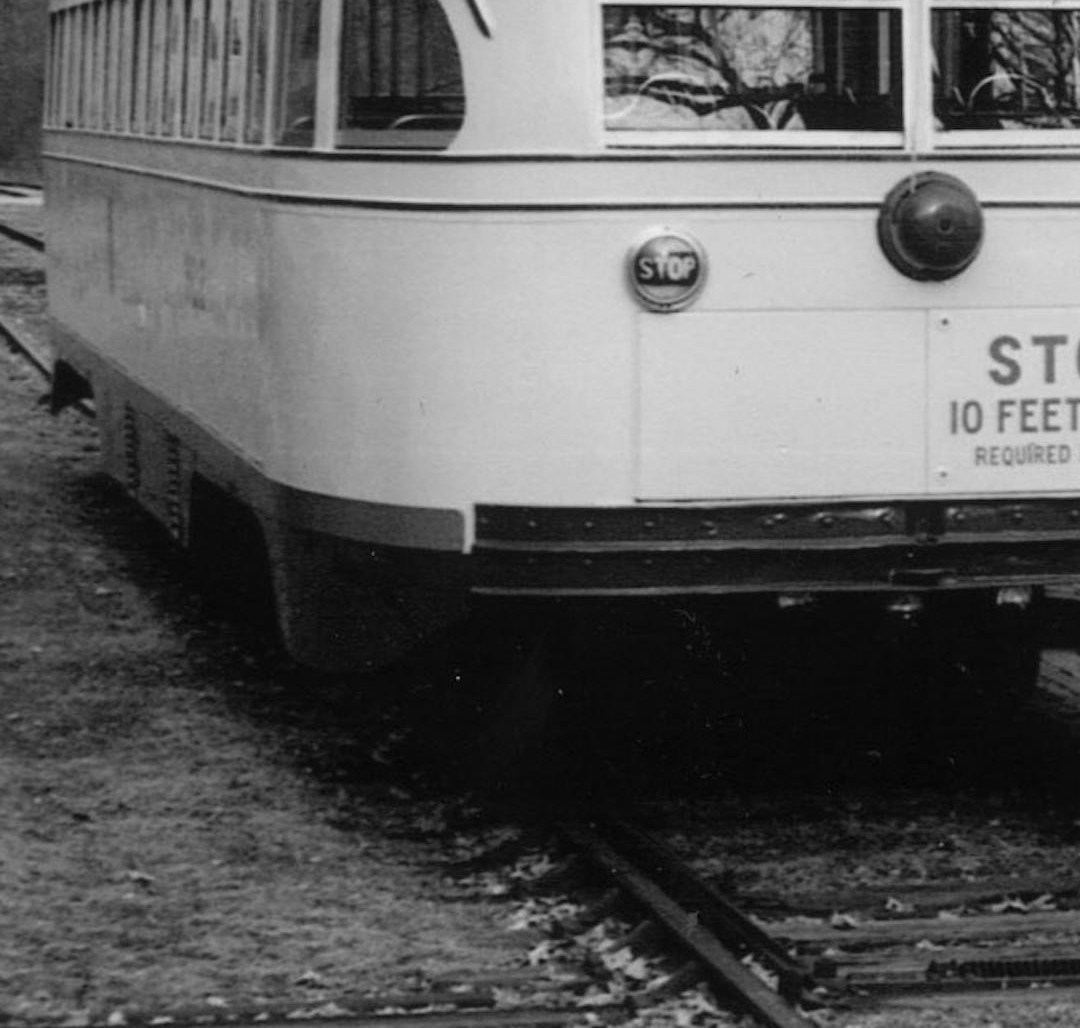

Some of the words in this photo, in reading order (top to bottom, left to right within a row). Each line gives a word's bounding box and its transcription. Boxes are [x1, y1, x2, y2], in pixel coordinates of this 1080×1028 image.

[639, 256, 695, 281] STOP
[951, 400, 984, 434] 10
[974, 443, 1071, 466] REQUIRED
